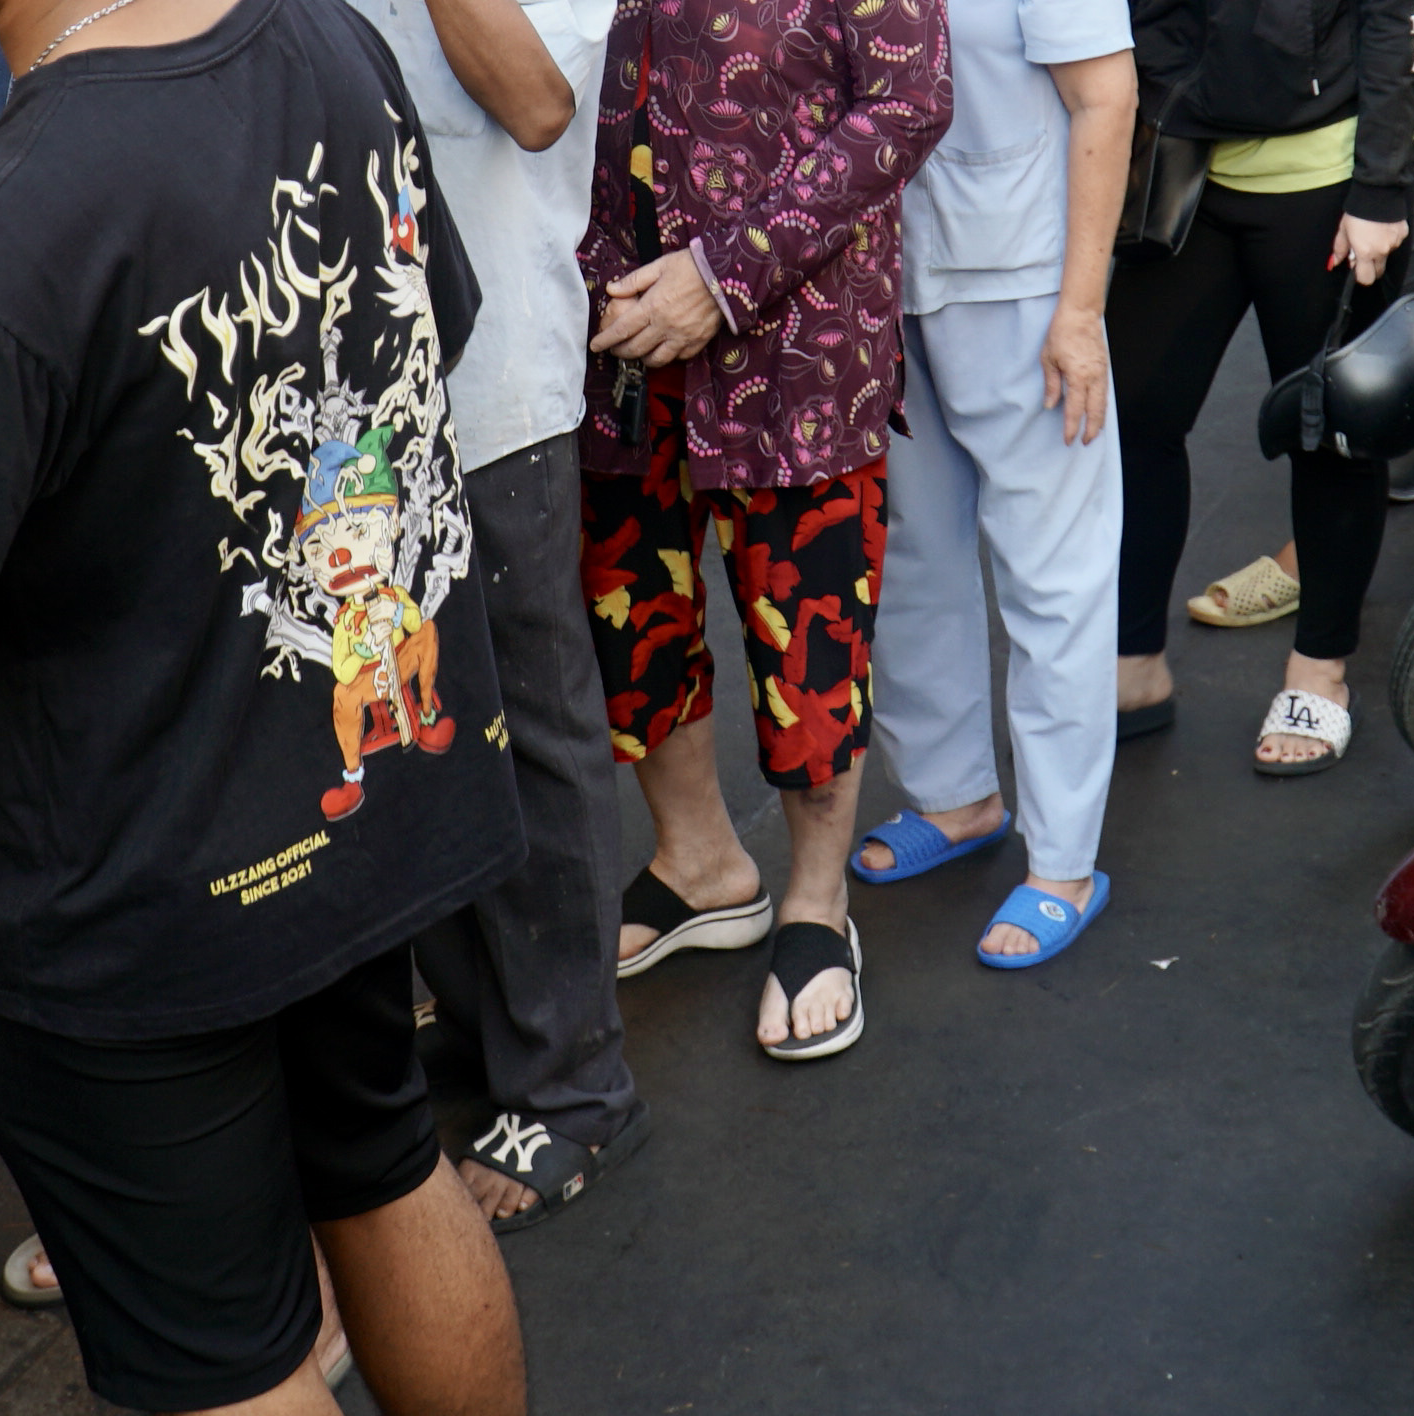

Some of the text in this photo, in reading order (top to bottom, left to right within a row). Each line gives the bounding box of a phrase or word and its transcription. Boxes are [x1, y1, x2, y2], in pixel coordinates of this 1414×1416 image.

[1284, 695, 1320, 731] LA
[209, 829, 331, 897] ULZZANG OFFICIAL
[240, 858, 312, 906] SINCE 2021
